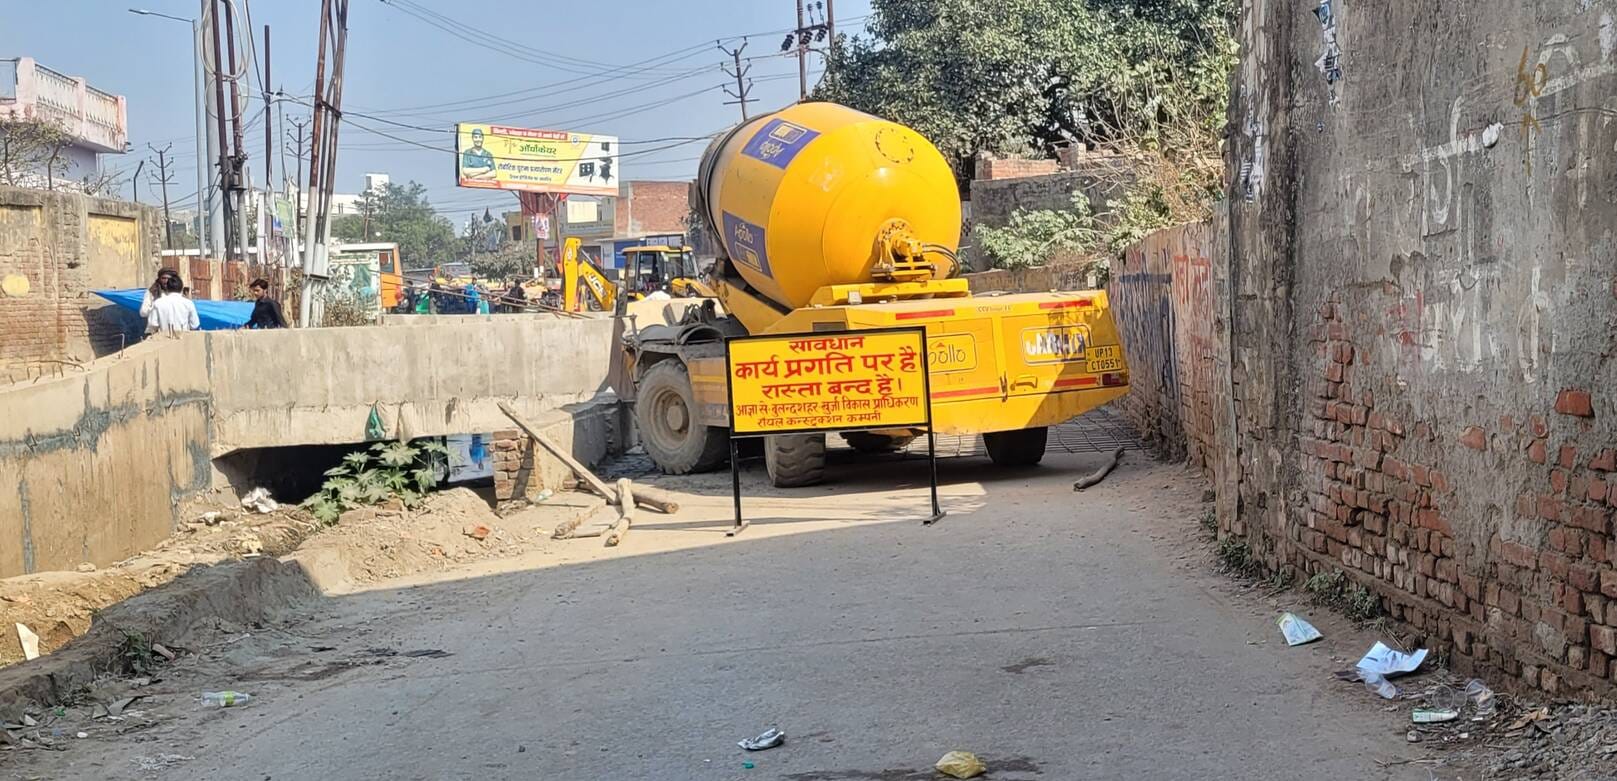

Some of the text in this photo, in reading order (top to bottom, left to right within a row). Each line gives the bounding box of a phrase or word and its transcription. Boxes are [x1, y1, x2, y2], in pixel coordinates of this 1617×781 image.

[789, 336, 865, 353] सावधान
[735, 354, 780, 379] कार्य
[784, 351, 855, 378] प्रगति
[860, 353, 895, 374] पर
[761, 382, 822, 399] रास्ता
[827, 379, 872, 396] बन्द
[736, 404, 758, 417] आज्ञा
[842, 395, 870, 410] विकास
[872, 396, 919, 410] प्राधिकरण
[846, 410, 881, 423] कम्पनी
